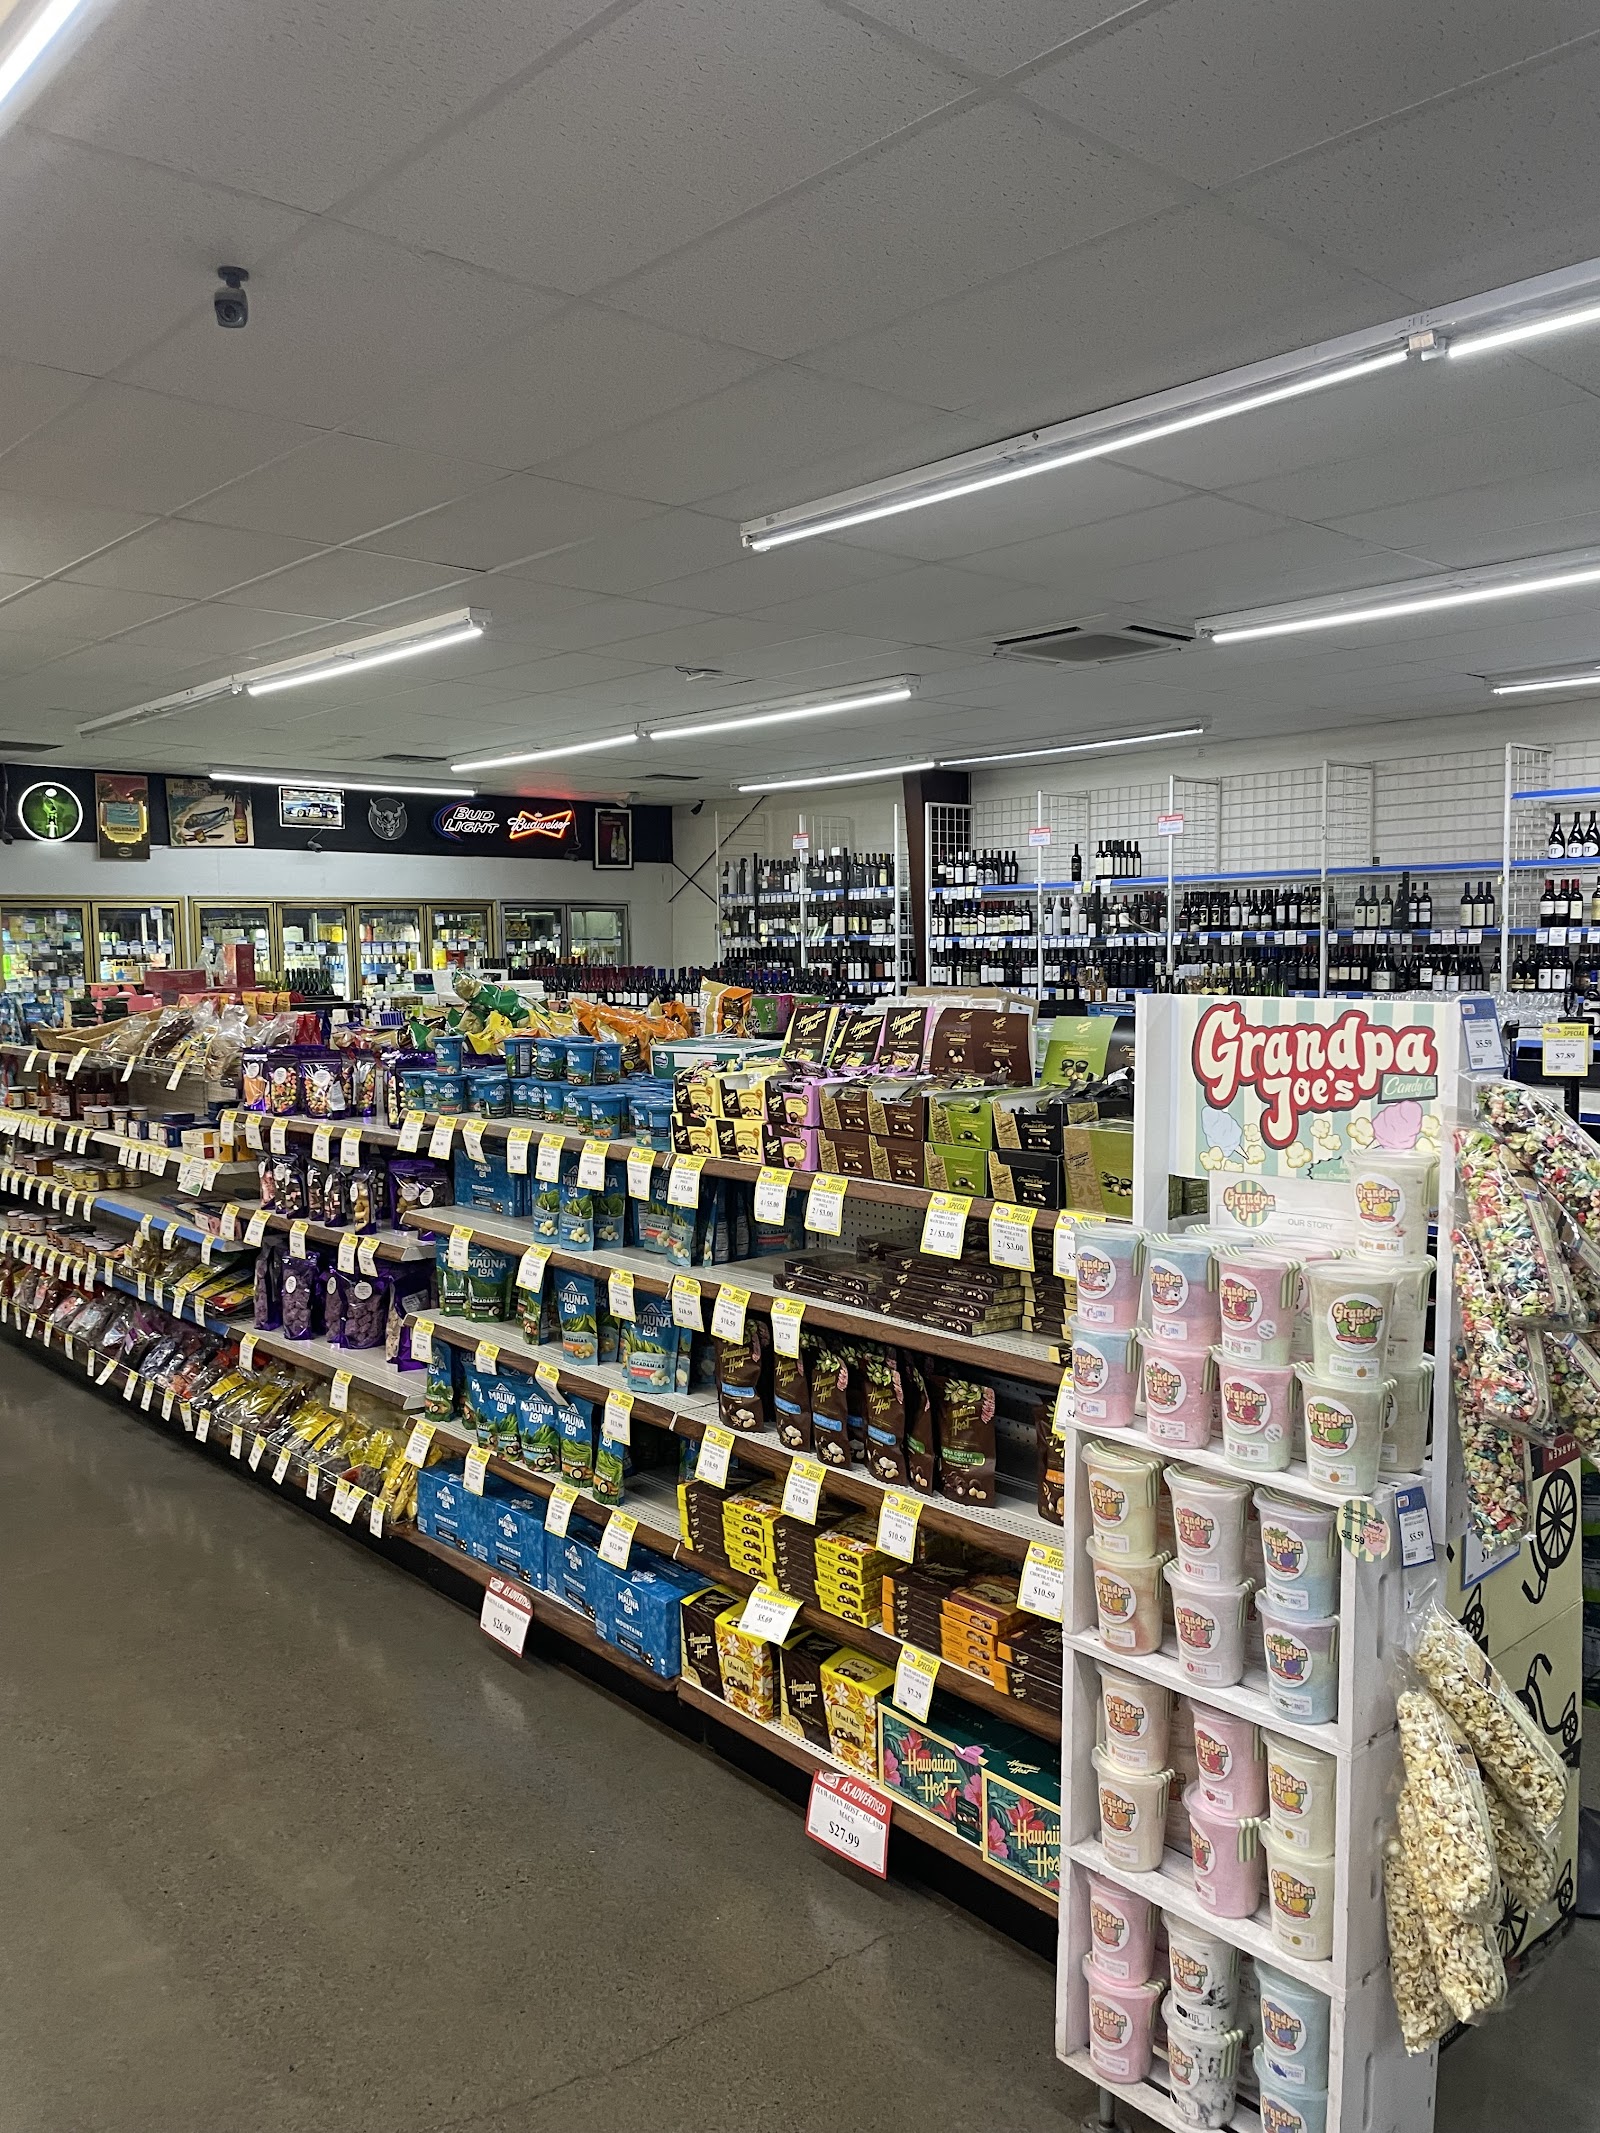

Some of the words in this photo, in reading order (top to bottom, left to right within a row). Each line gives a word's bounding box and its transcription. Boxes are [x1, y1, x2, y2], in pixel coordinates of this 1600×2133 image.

[453, 807, 495, 821] BUD
[443, 819, 499, 833] LIGHT
[507, 818, 570, 832] Budweiser
[796, 1009, 827, 1030] Hawaiian
[800, 1016, 826, 1037] Host
[849, 1014, 884, 1034] Hawaiian
[890, 1009, 922, 1031] Hawaiian
[853, 1022, 881, 1041] Host
[895, 1018, 921, 1039] Host
[1195, 1001, 1439, 1102] Grandpa
[1476, 1039, 1492, 1049] $5.59
[1383, 1077, 1421, 1097] Candy
[1262, 1072, 1357, 1146] Joe's
[1223, 1187, 1276, 1211] Grandpa
[1356, 1184, 1399, 1204] Grandpa
[819, 1209, 833, 1217] $3.00
[948, 1202, 967, 1211] SPECIAL
[1011, 1212, 1031, 1222] SPECIAL
[1288, 1218, 1307, 1227] OUR
[1309, 1220, 1333, 1230] STORY
[938, 1230, 954, 1239] $3.00
[1007, 1242, 1024, 1252] $3.00
[468, 1259, 507, 1270] MAUNA
[477, 1268, 495, 1278] LOA
[559, 1291, 589, 1305] MAUNA
[564, 1303, 577, 1315] LOA
[1332, 1302, 1383, 1322] Grandpa
[636, 1313, 672, 1328] MAUNA
[642, 1325, 658, 1337] LOA
[488, 1391, 516, 1405] MAUNA
[1224, 1383, 1267, 1402] Grandpa
[496, 1403, 507, 1413] LOA
[1307, 1402, 1353, 1424] Grandpa
[529, 1412, 543, 1424] LOA
[558, 1410, 586, 1429] MAUNA
[565, 1424, 577, 1437] LOA
[805, 1468, 821, 1480] SPECIAL
[900, 1503, 917, 1515] SPECIAL
[434, 1513, 458, 1527] MOUNTAINS
[1176, 1508, 1214, 1527] Grandpa
[1364, 1521, 1383, 1533] Candy
[888, 1530, 907, 1543] $10.59
[1264, 1529, 1302, 1550] Grandpa
[1341, 1530, 1365, 1545] $5.59
[1410, 1531, 1424, 1542] $5.59
[496, 1541, 521, 1557] MOUNTAINS
[1033, 1586, 1056, 1600] $10.59
[617, 1592, 640, 1611] MAUNA
[757, 1614, 772, 1624] $5.69
[1176, 1608, 1214, 1627] Grandpa
[493, 1617, 512, 1636] $26.99
[615, 1618, 643, 1639] MOUNTAINS
[1266, 1635, 1307, 1657] Grandpa
[727, 1660, 738, 1675] Island
[917, 1660, 934, 1674] SPECIAL
[907, 1687, 921, 1699] $7.29
[1106, 1694, 1144, 1717] Grandpa
[835, 1709, 848, 1725] Island
[848, 1716, 860, 1729] Macs
[902, 1748, 957, 1778] Hawaiian
[917, 1773, 961, 1803] Host
[840, 1781, 852, 1795] AS
[850, 1785, 886, 1816] ADVERTISED
[815, 1785, 843, 1807] HAWAIIAN
[843, 1803, 859, 1816] HOST
[863, 1814, 884, 1831] ISLAND
[839, 1809, 855, 1824] MACS
[828, 1820, 860, 1848] $27.99
[1009, 1819, 1060, 1850] Hawaii
[1271, 1869, 1315, 1895] Grandpa
